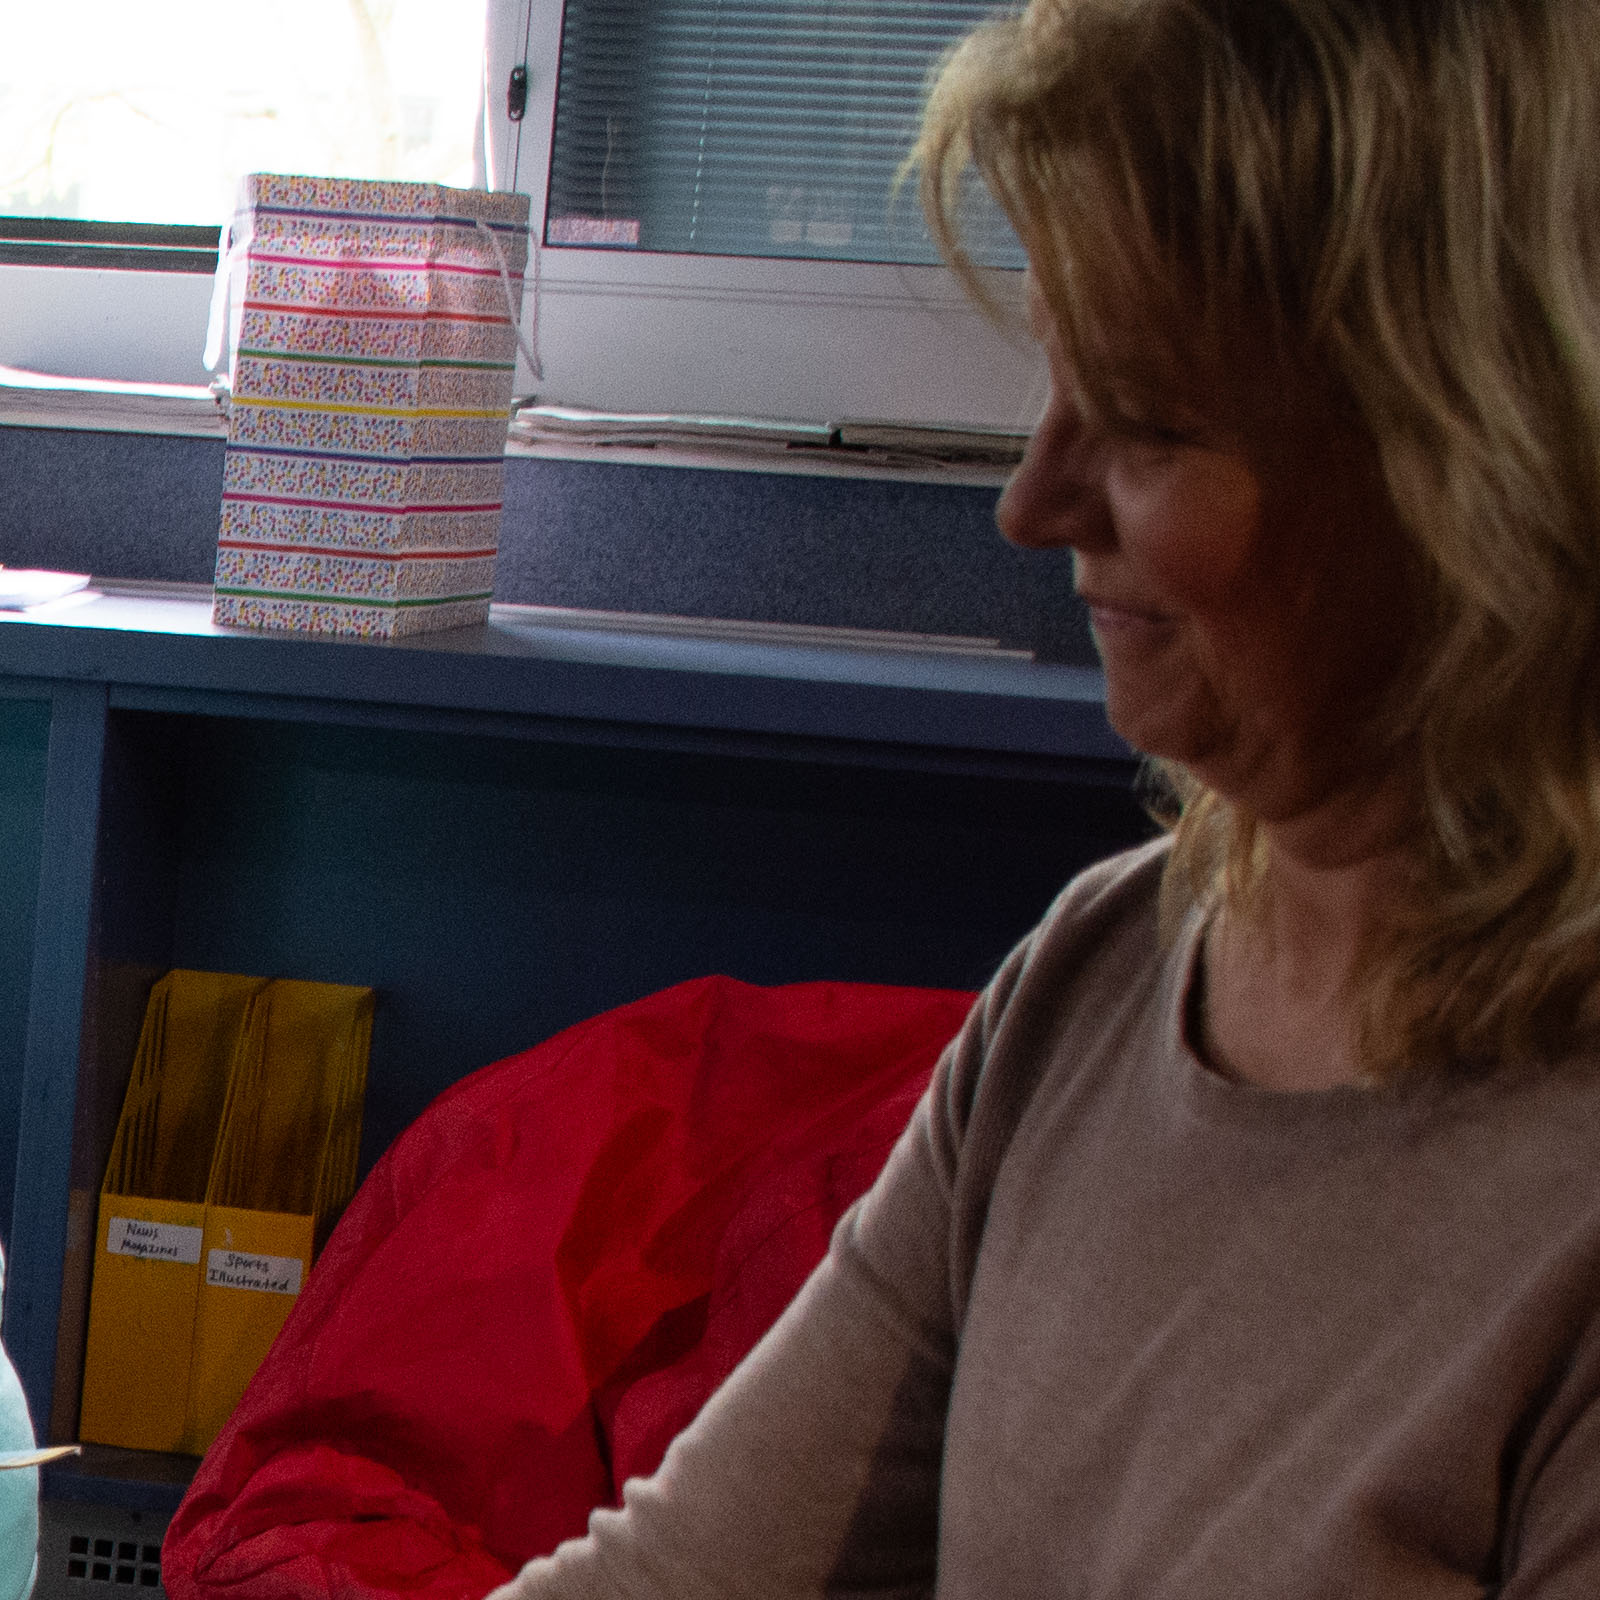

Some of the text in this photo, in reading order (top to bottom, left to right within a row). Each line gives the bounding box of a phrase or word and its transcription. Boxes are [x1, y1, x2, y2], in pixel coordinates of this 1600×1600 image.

[126, 1222, 160, 1240] News
[224, 1253, 271, 1273] Sports
[208, 1268, 290, 1292] Illustrated
